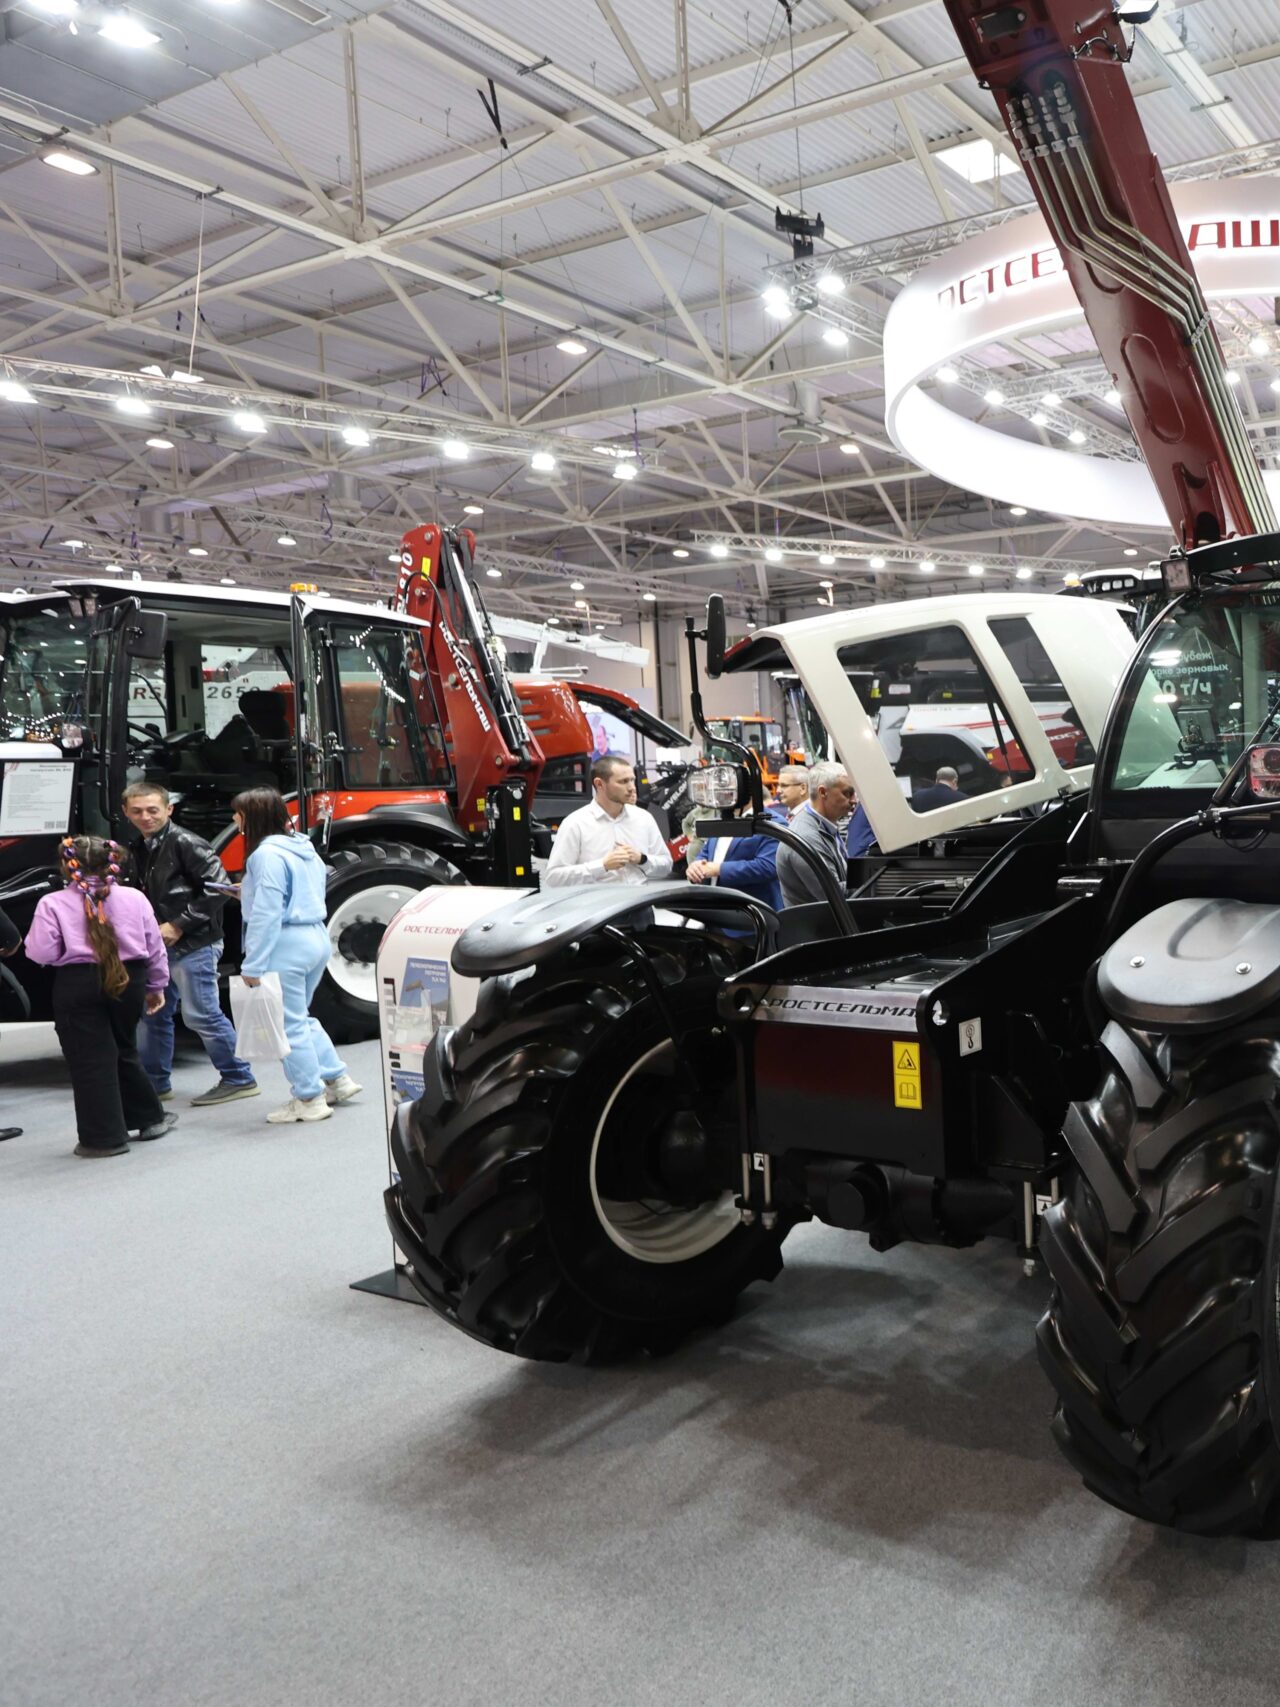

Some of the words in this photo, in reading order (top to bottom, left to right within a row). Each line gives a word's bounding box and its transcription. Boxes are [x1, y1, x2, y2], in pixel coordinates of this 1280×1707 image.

[1176, 663, 1229, 676] зерновых
[1180, 678, 1212, 696] т/ч
[403, 925, 467, 936] РОСТСЕЛЬМ
[767, 998, 917, 1018] РОСТСЕЛЬМА
